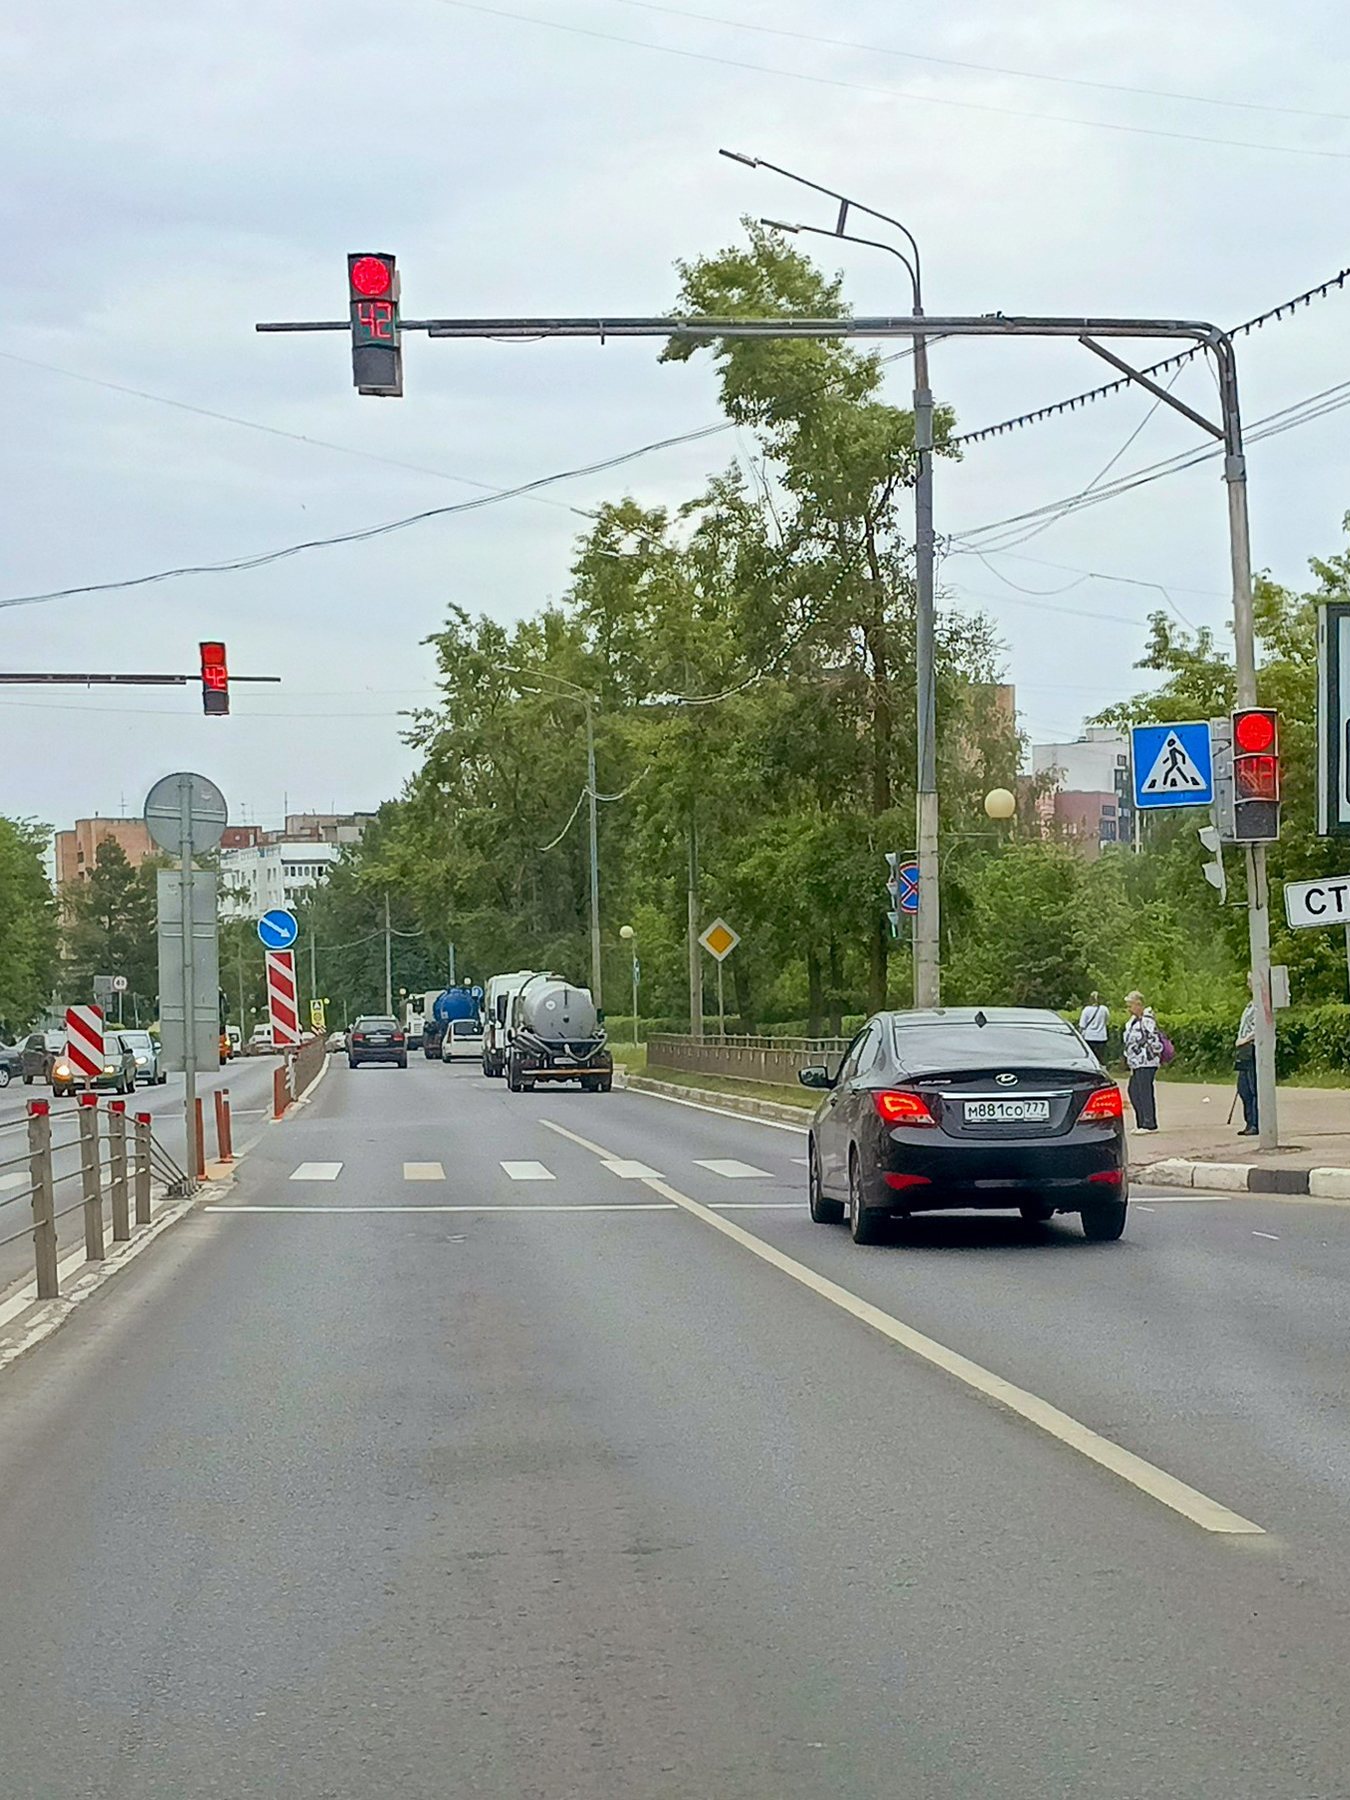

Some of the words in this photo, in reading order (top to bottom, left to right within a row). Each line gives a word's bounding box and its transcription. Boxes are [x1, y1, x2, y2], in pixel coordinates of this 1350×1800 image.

[357, 302, 392, 338] 42
[205, 667, 226, 687] 42
[1024, 1102, 1046, 1113] 777
